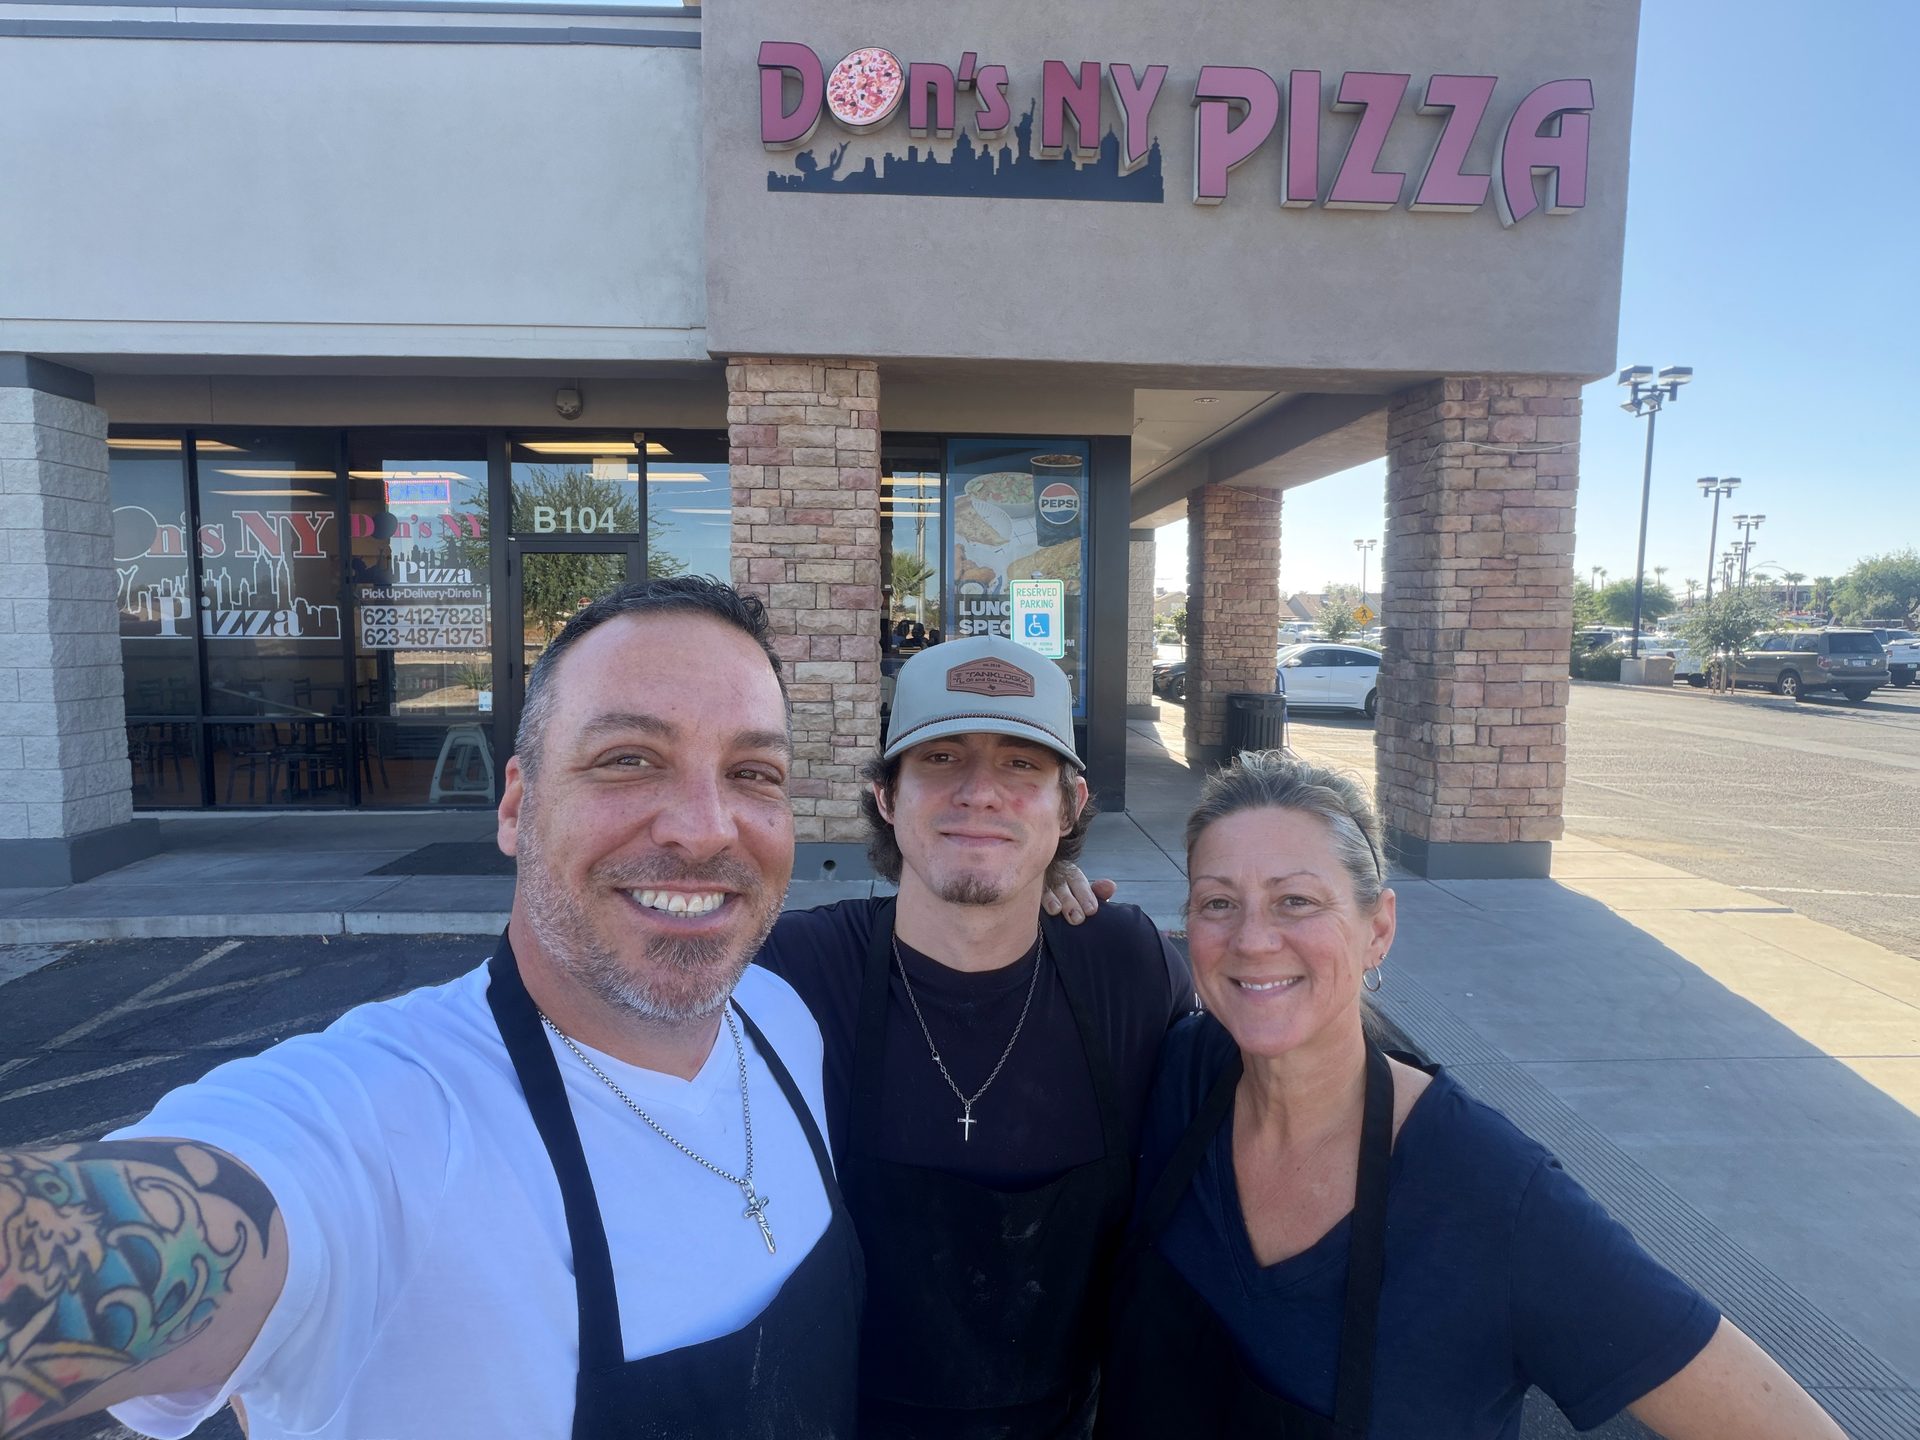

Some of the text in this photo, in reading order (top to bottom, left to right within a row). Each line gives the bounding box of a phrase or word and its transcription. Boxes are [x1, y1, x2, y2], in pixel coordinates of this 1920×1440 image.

[1041, 60, 1169, 170] NY
[1190, 65, 1595, 229] PIZZA
[1041, 499, 1078, 508] PEPSI
[439, 513, 485, 539] NY
[534, 506, 617, 534] B104
[231, 510, 334, 559] NY
[398, 560, 473, 584] Pizza
[361, 588, 385, 599] Pick
[472, 588, 482, 598] In
[1016, 587, 1058, 597] RESERVED
[1020, 599, 1054, 609] PARKING
[154, 596, 304, 637] Pizza
[363, 607, 484, 626] 623-412-7828
[364, 627, 484, 646] 623-487-1375
